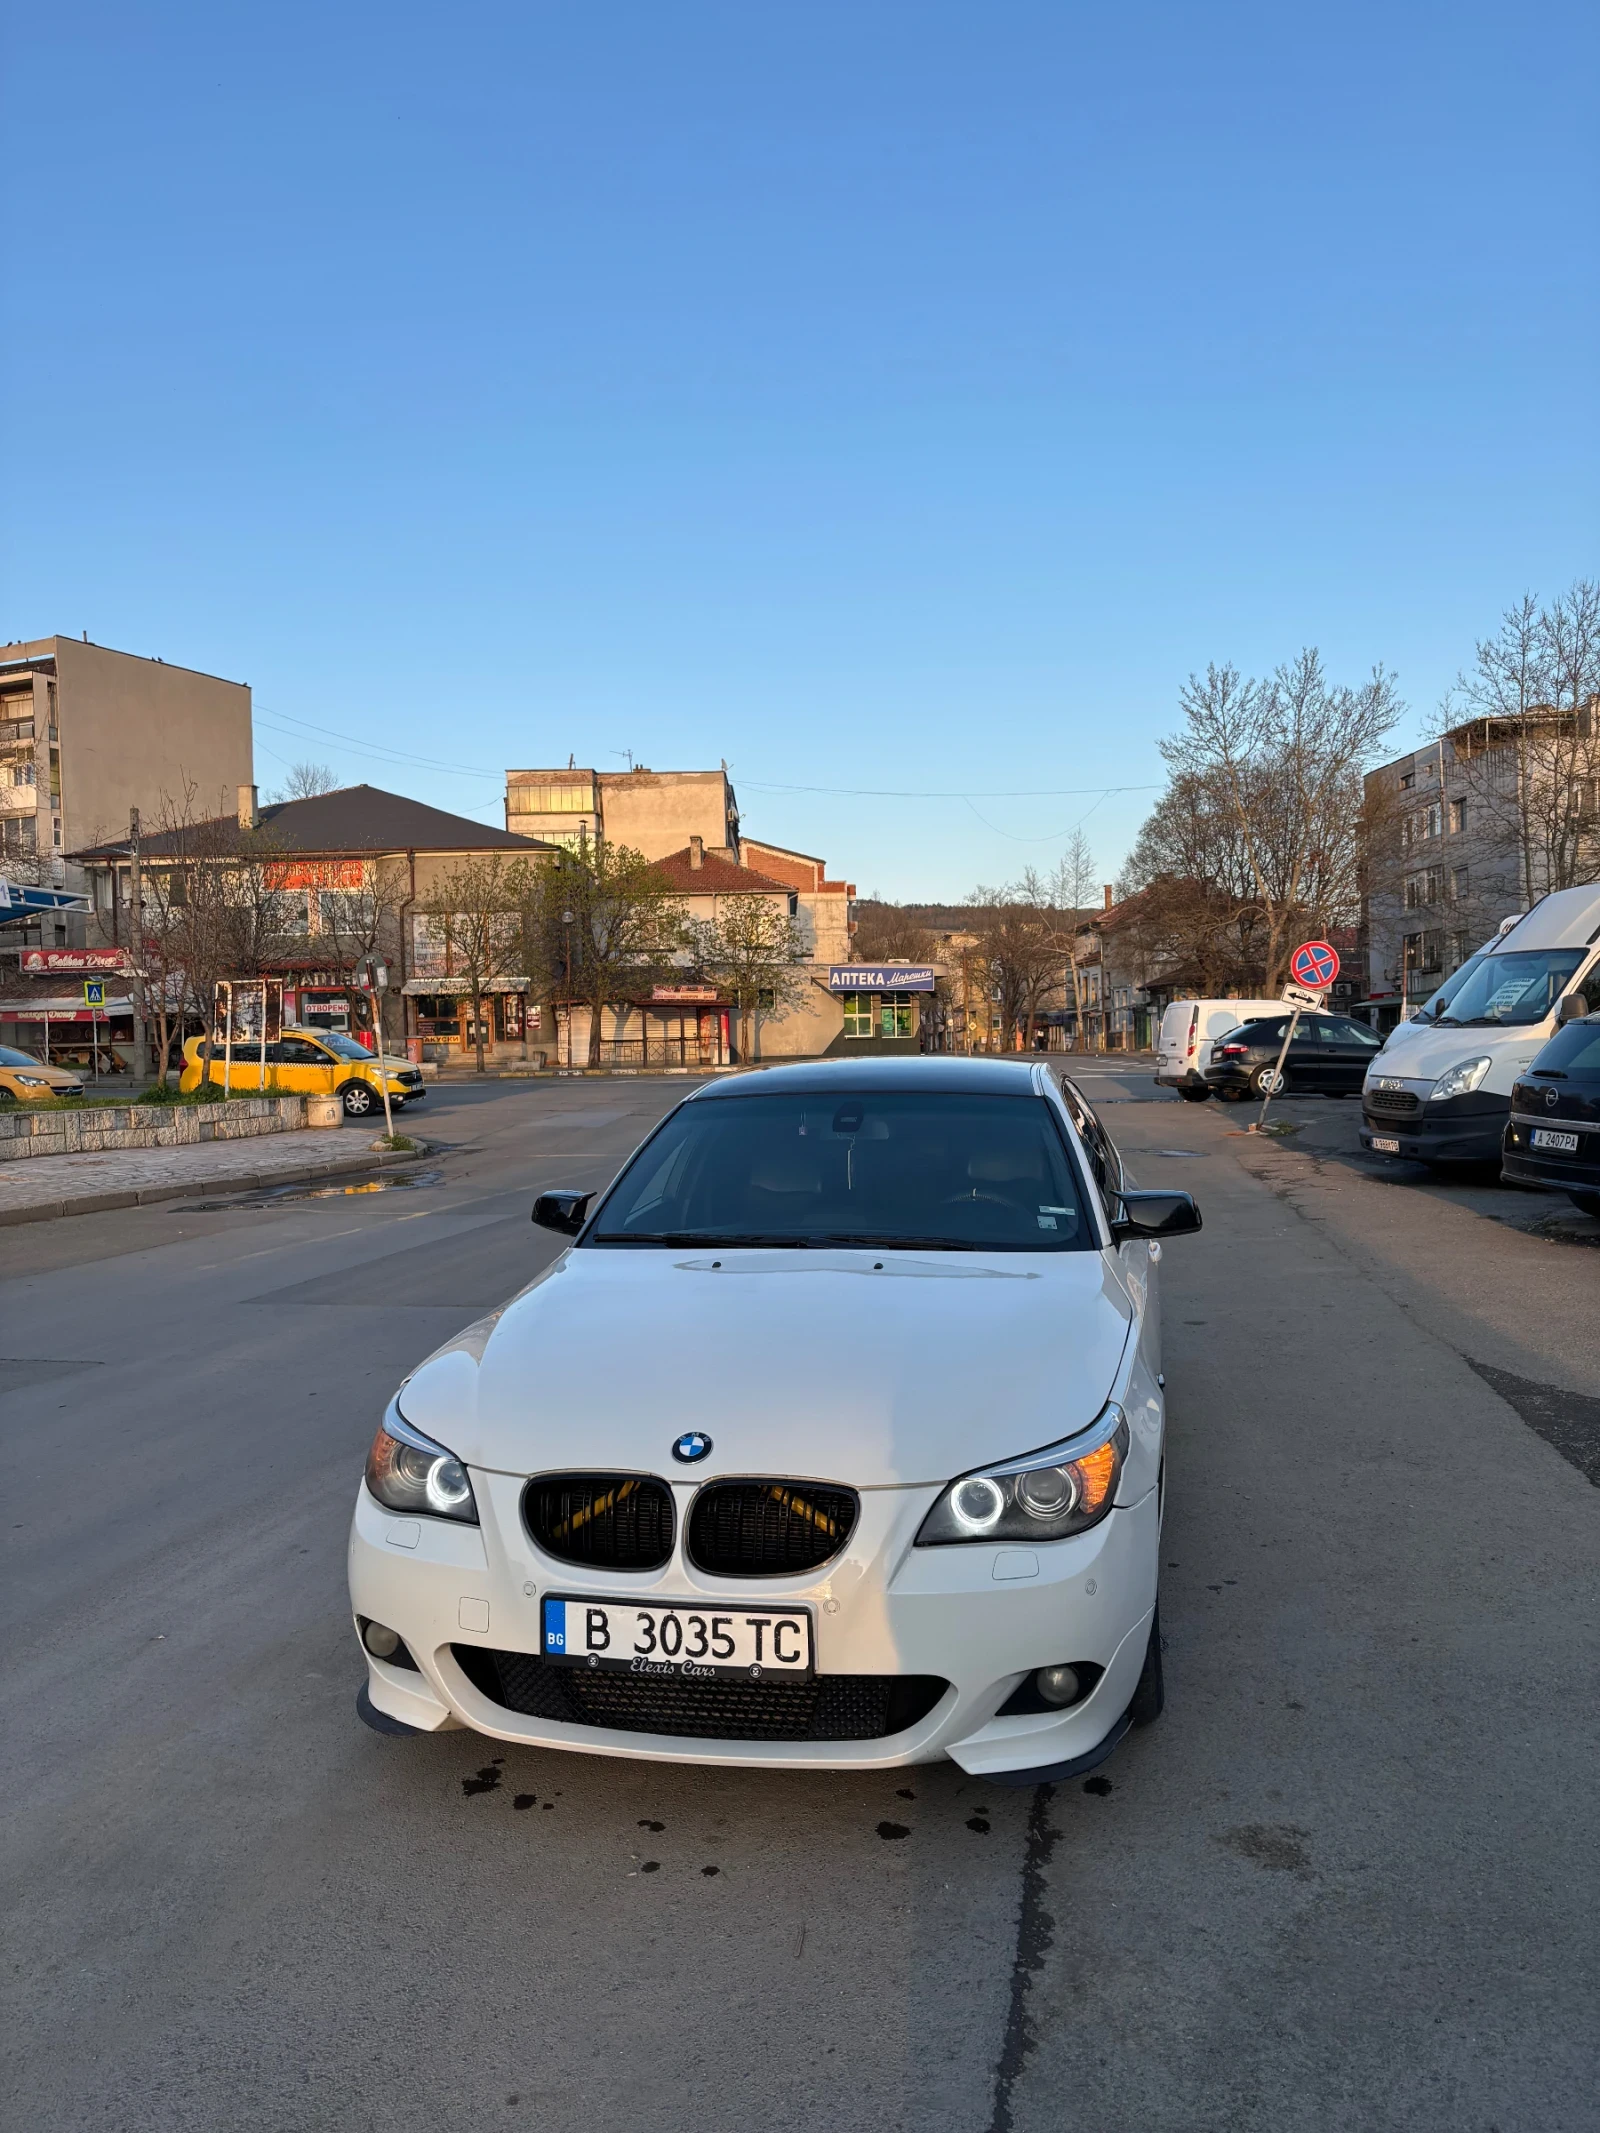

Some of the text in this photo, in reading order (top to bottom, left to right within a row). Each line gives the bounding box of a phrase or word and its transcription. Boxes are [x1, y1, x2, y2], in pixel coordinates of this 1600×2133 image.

[831, 970, 932, 985] АПТЕКА Марешки
[306, 1004, 349, 1012] ОТВОРЕНО
[547, 1632, 564, 1645] BG
[586, 1608, 611, 1650] B
[630, 1657, 716, 1677] Elexis Cars
